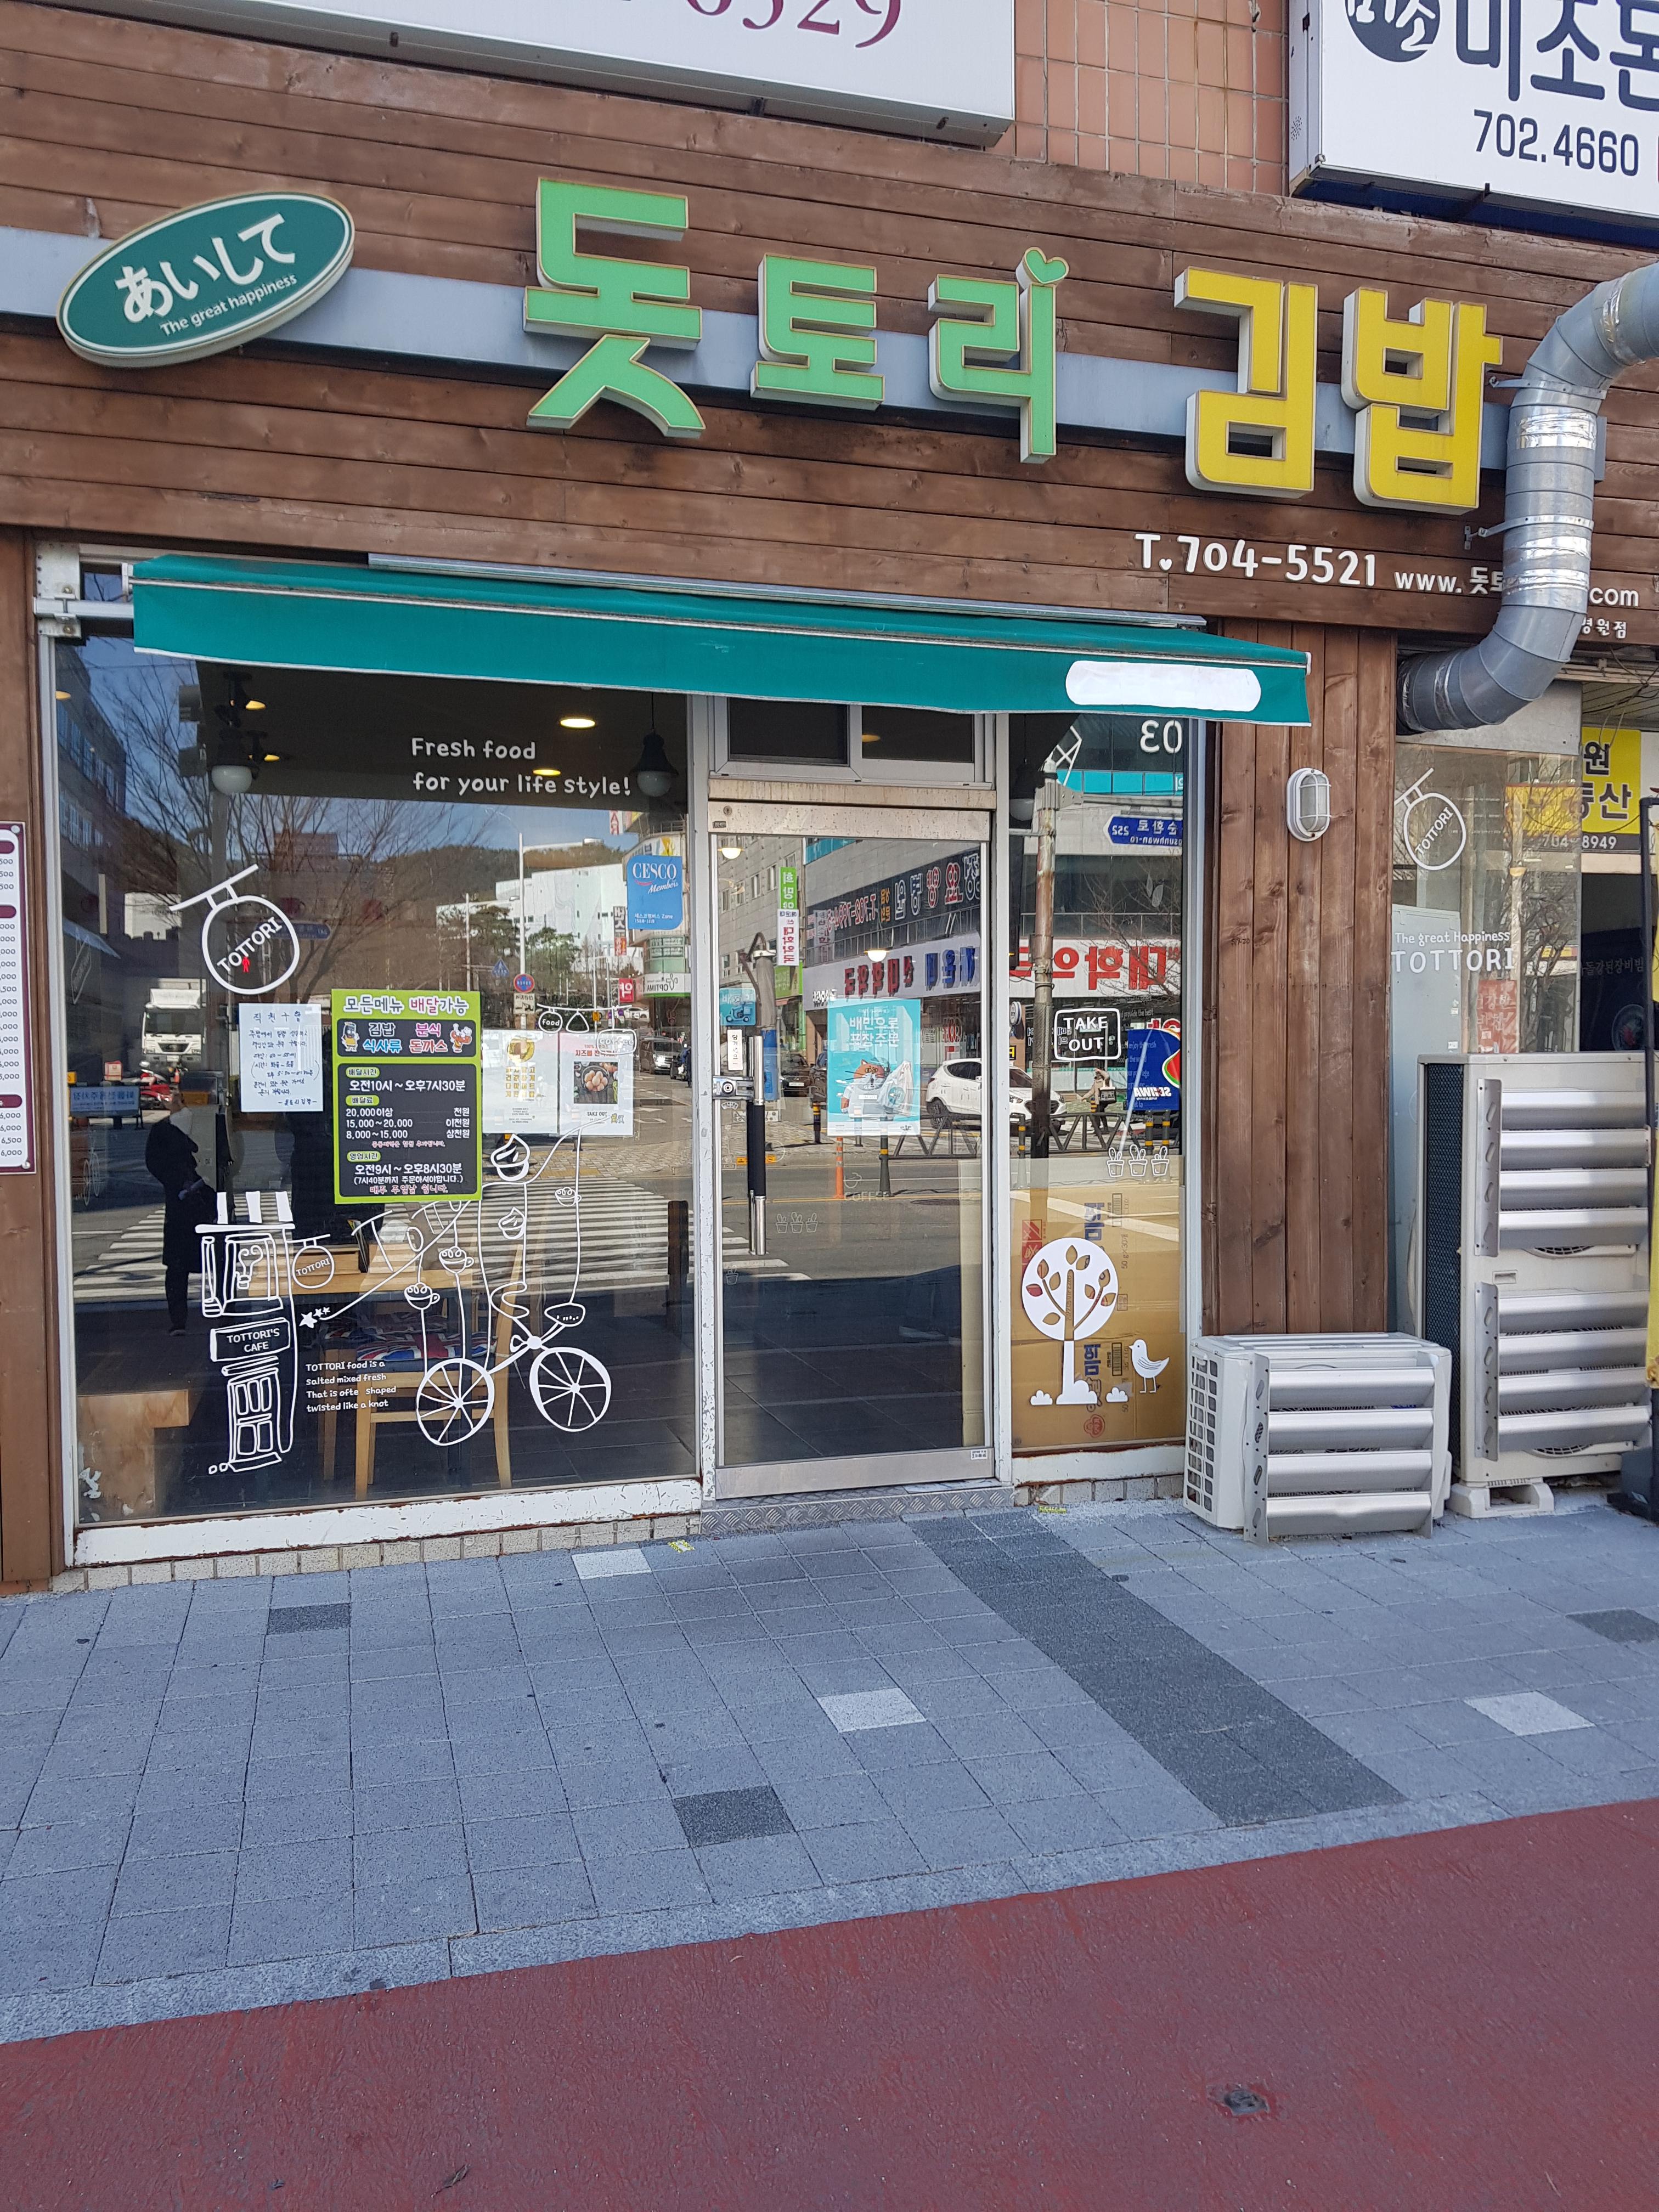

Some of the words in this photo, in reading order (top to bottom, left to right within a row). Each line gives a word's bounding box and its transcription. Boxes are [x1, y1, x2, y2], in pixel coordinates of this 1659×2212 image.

[1474, 110, 1639, 176] 702.4660
[115, 212, 295, 323] あいして
[160, 319, 189, 336] The
[191, 302, 228, 327] great
[228, 274, 297, 309] happiness
[523, 177, 1068, 462] 돗토리
[1174, 266, 1503, 515] 김밥
[411, 737, 475, 758] Fresh
[482, 740, 536, 760] food
[413, 772, 449, 791] for
[458, 776, 509, 796] your
[518, 774, 557, 793] life
[564, 776, 631, 799] style!
[1415, 806, 1454, 857] TOTTORI
[633, 862, 677, 880] CESCO
[648, 879, 679, 894] Members
[217, 916, 283, 974] TOTTORI
[1395, 932, 1415, 944] The
[1418, 932, 1450, 946] great
[1453, 931, 1510, 946] Happiness
[1391, 947, 1516, 974] TOTTORI
[343, 995, 404, 1014] 모든메뉴
[409, 995, 469, 1015] 배달가능
[369, 1022, 396, 1037] 김밥
[416, 1023, 441, 1037] 분식
[849, 1016, 899, 1031] 배민으로
[1064, 1016, 1108, 1030] TAKE
[363, 1039, 402, 1053] 식사류
[409, 1039, 448, 1053] 돈까스
[599, 1037, 634, 1047] coffee
[1069, 1037, 1104, 1052] OUT
[346, 1108, 393, 1117] 20,000이상
[454, 1107, 470, 1116] 천원
[445, 1119, 470, 1127] 이천원
[446, 1129, 470, 1138] 삼천원
[354, 1176, 398, 1186] (7시40분까지
[370, 1186, 387, 1194] 매주
[391, 1185, 416, 1194] 주일날
[421, 1184, 449, 1193] 쉽니다.
[296, 1258, 331, 1277] TOTTORI
[227, 1328, 280, 1344] TOTTORI'S
[244, 1341, 269, 1352] CAFE
[306, 1362, 345, 1372] TOTTORI
[347, 1361, 367, 1369] food
[306, 1376, 335, 1385] salted
[337, 1374, 361, 1384] mixed
[363, 1373, 386, 1381] fresh
[306, 1390, 328, 1398] That
[339, 1388, 359, 1397] ofte
[365, 1386, 397, 1395] shaped
[307, 1402, 341, 1413] twisted
[343, 1401, 359, 1409] like
[369, 1399, 389, 1408] knot
